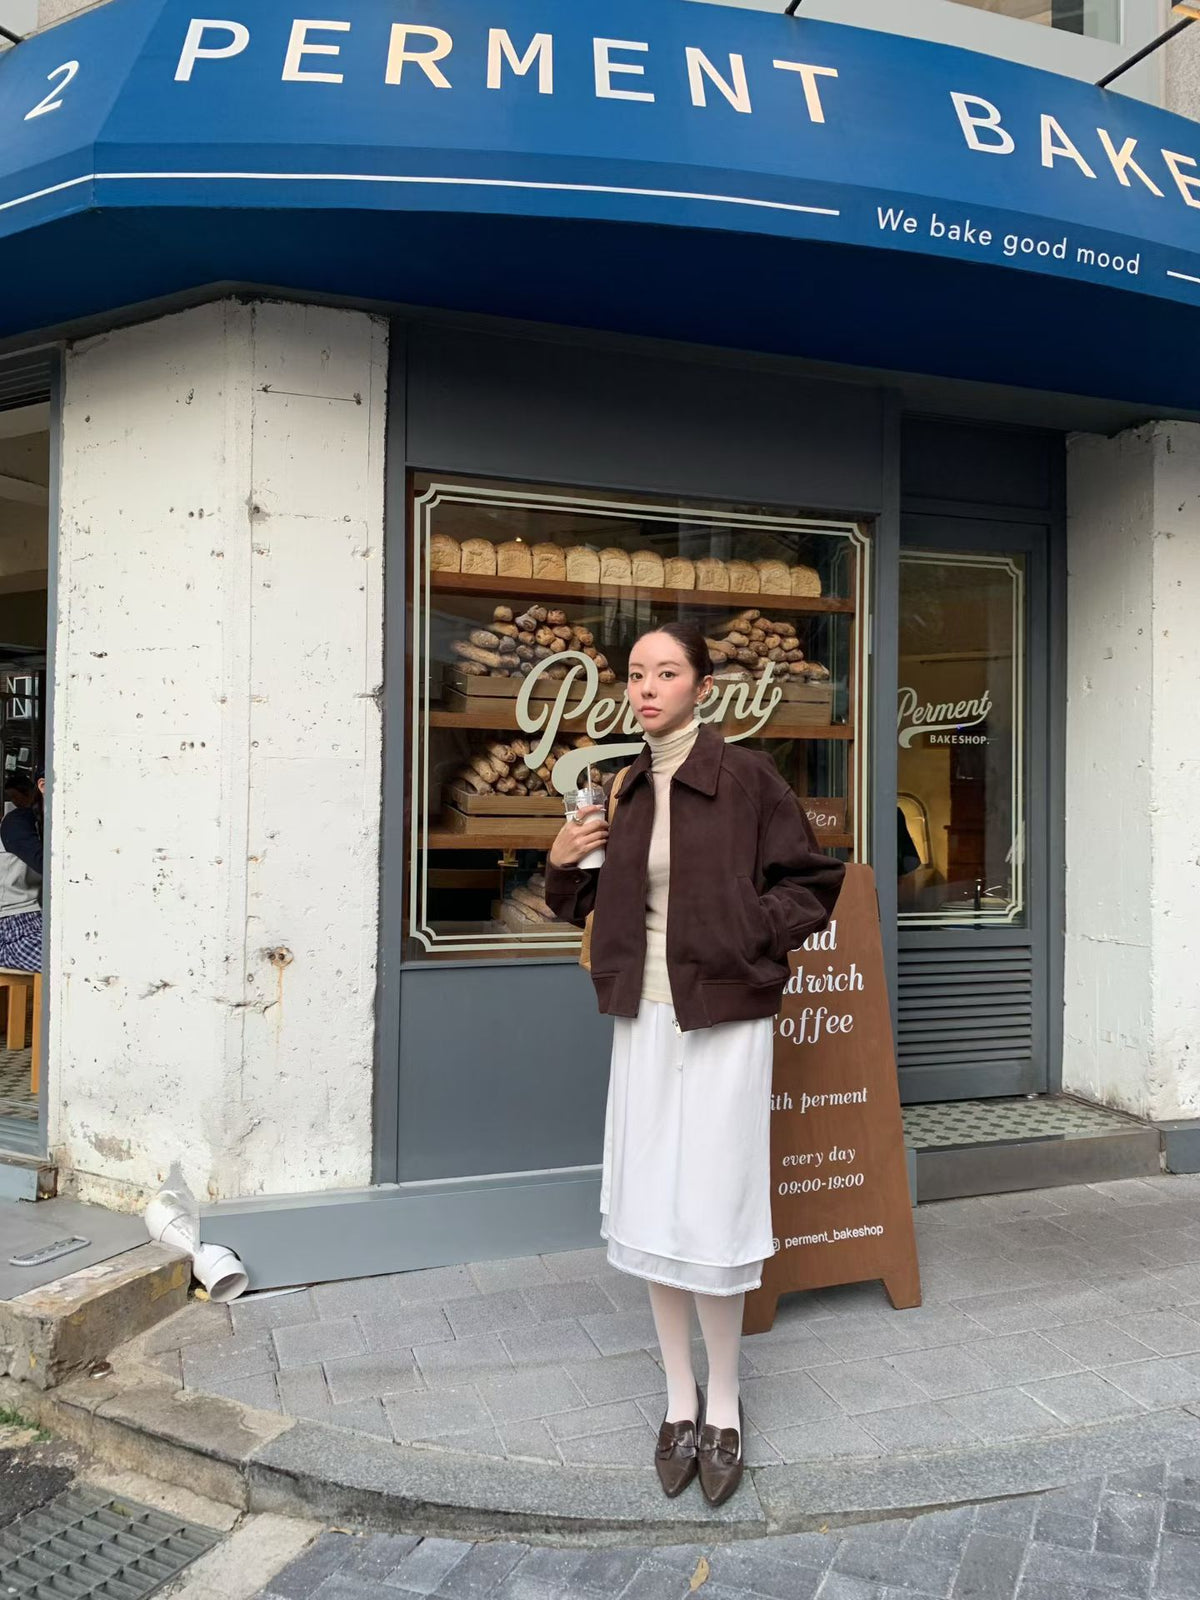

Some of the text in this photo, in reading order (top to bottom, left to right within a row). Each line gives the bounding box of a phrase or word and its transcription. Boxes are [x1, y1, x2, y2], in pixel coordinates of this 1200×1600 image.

[23, 59, 80, 121] 2
[174, 18, 1200, 210] PERMENT BAKE
[876, 206, 1141, 275] We bake good mood
[515, 649, 783, 771] Perent
[896, 686, 993, 729] Perment
[804, 809, 838, 828] pen
[782, 963, 865, 995] dwich
[800, 1087, 868, 1114] perment
[782, 1145, 856, 1168] every day
[777, 1172, 865, 1196] 09:00-19:00
[784, 1223, 884, 1249] perment_bakeshop
